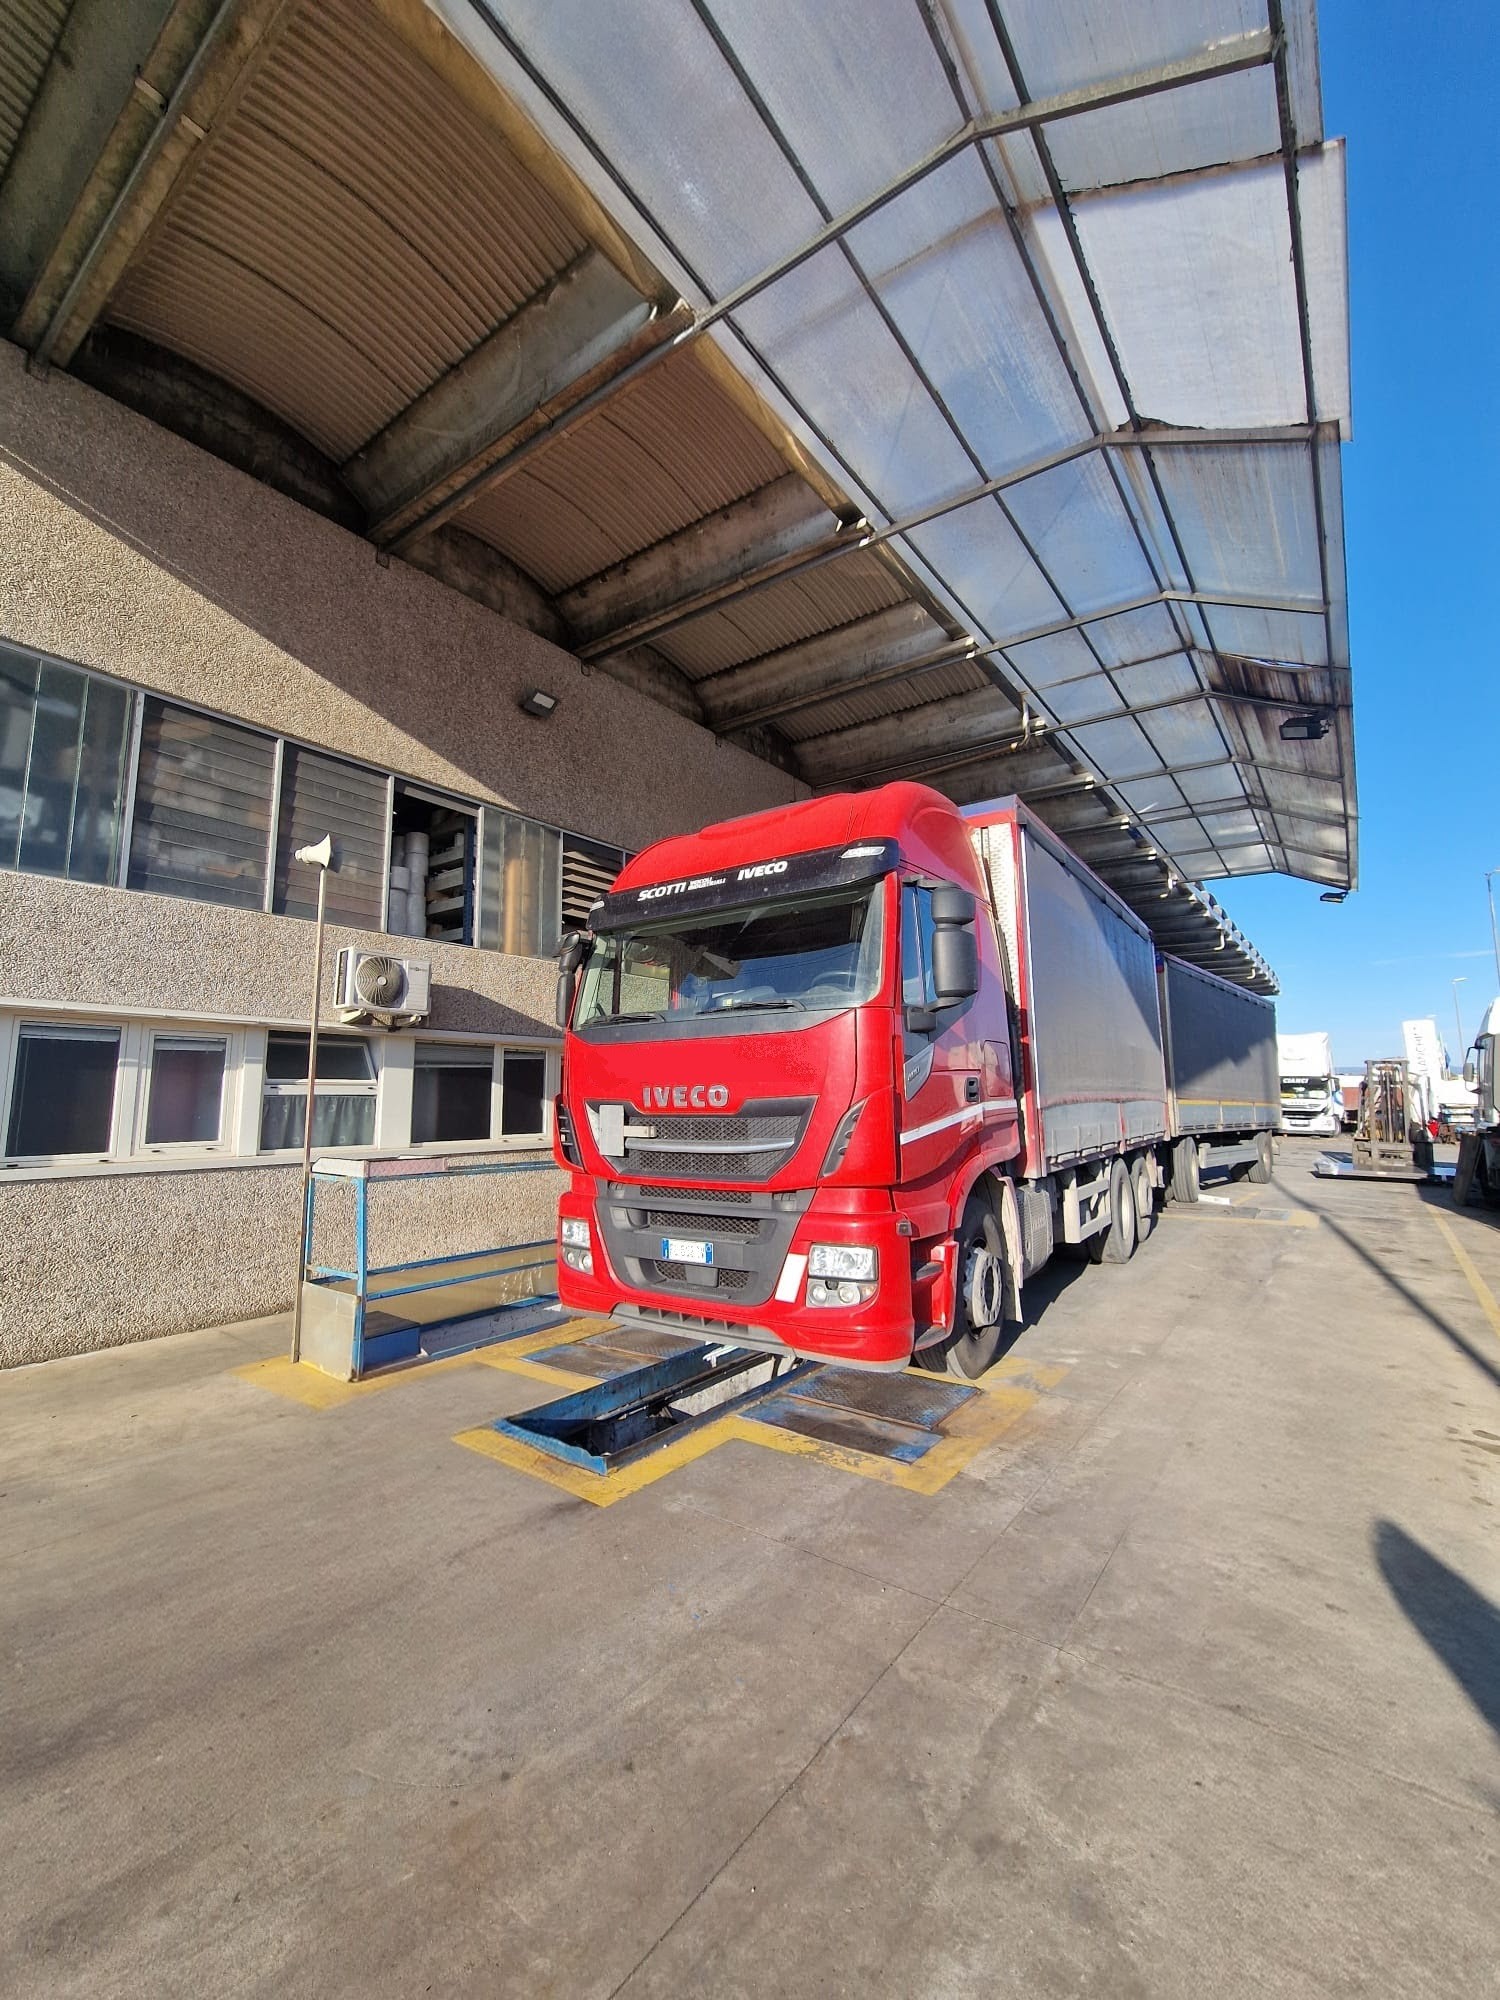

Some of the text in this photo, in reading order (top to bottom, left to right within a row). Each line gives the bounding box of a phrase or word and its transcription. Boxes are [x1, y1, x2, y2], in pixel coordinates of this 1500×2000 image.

[737, 861, 788, 880] IVECO
[637, 882, 687, 901] SCOTTI
[642, 1085, 730, 1108] IVECO
